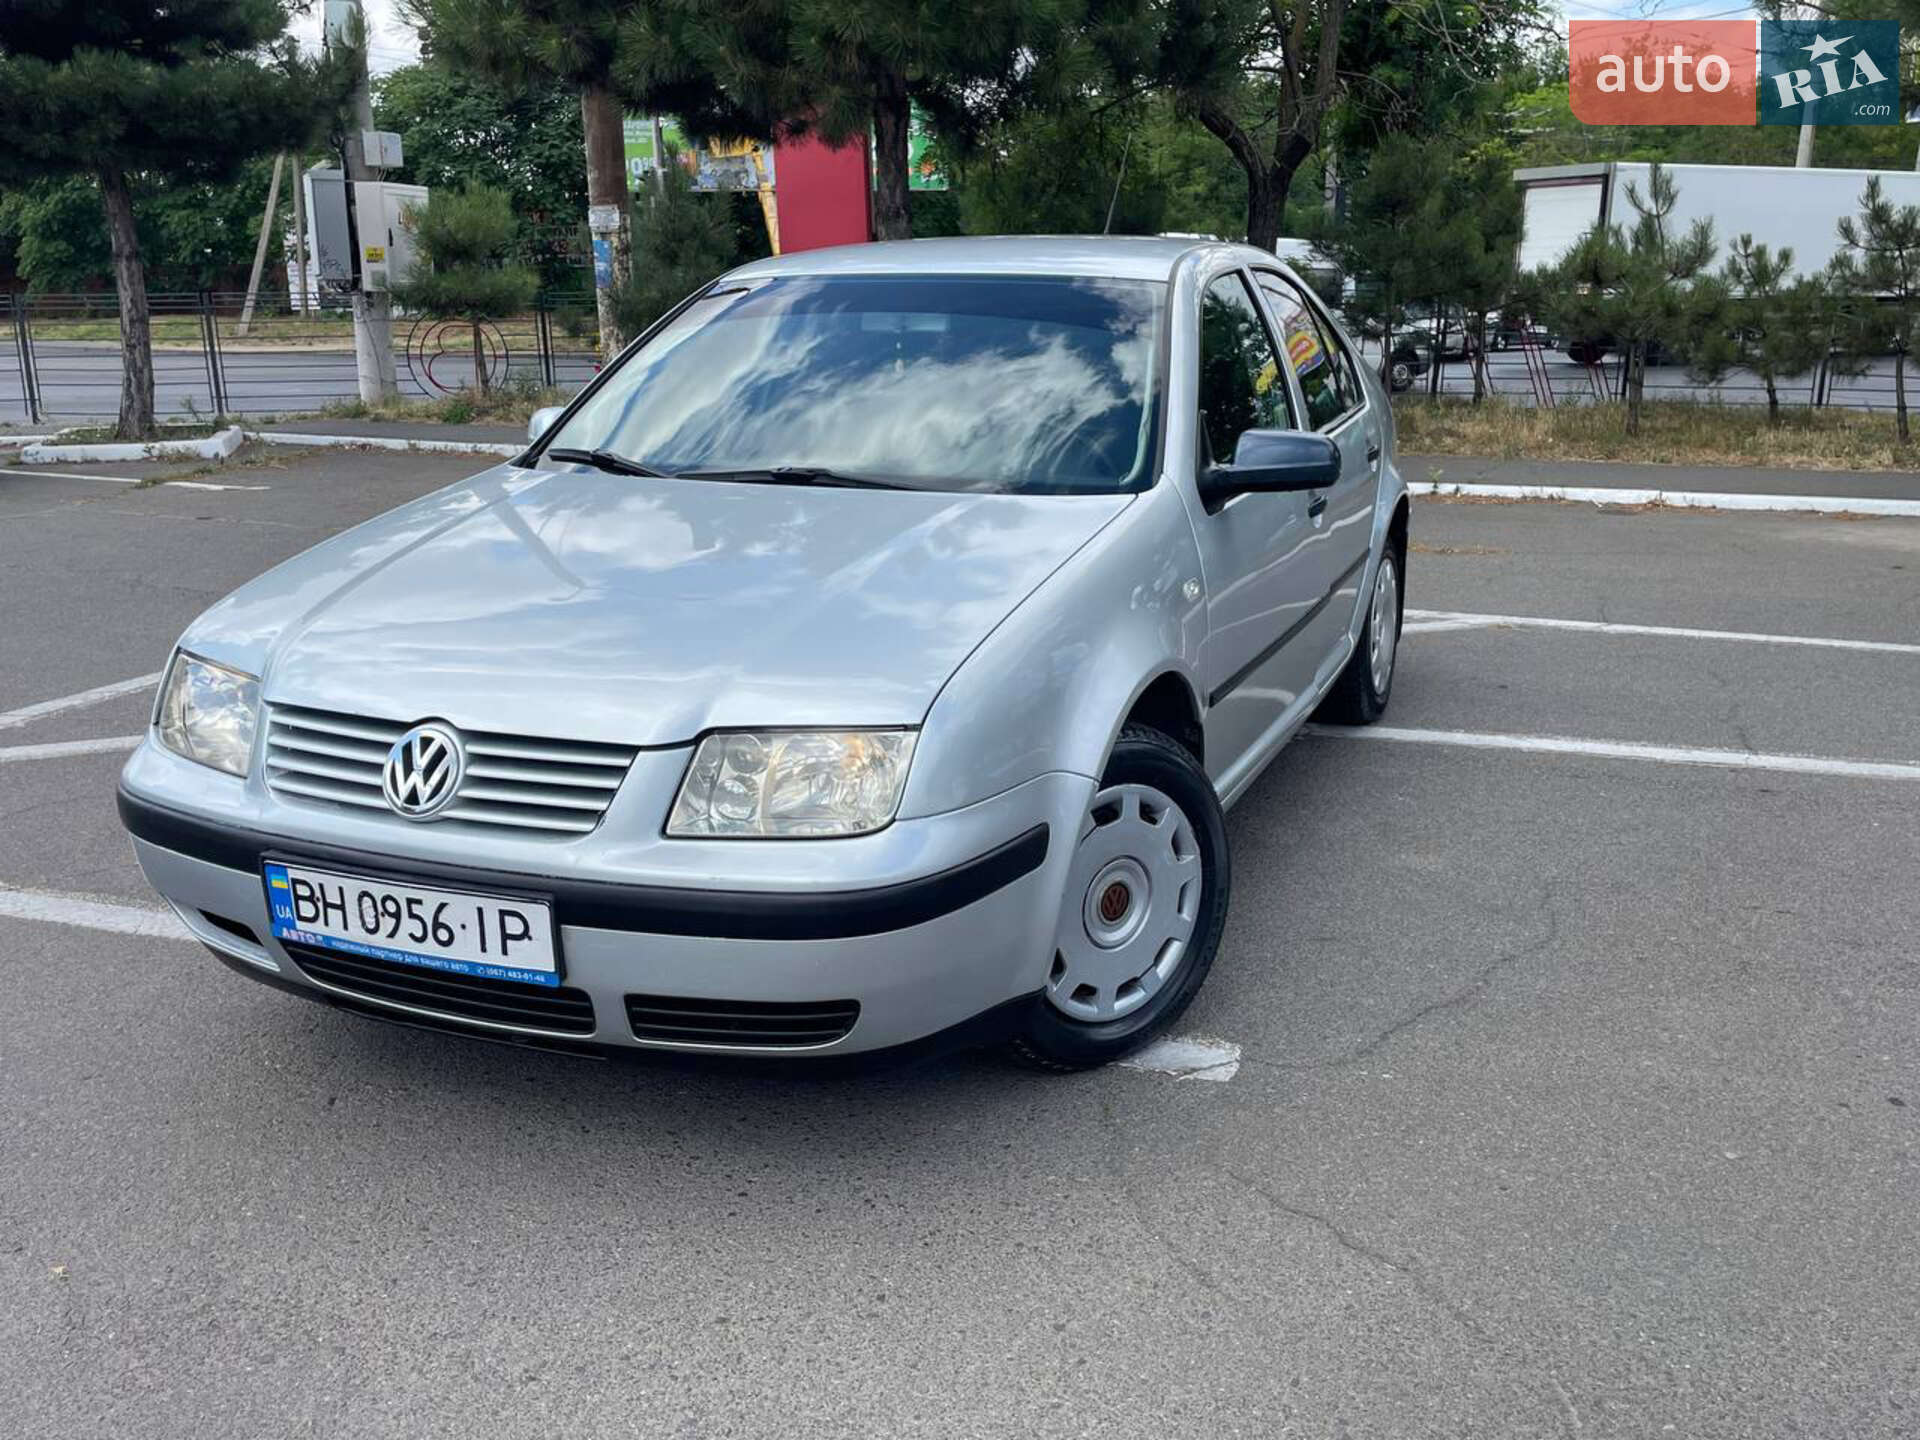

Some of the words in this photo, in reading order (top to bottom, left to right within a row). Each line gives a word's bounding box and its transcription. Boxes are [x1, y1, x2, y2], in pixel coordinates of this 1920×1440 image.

[275, 904, 293, 920] UA
[291, 876, 349, 931] BH
[357, 890, 456, 947] 0956
[476, 906, 532, 956] IP
